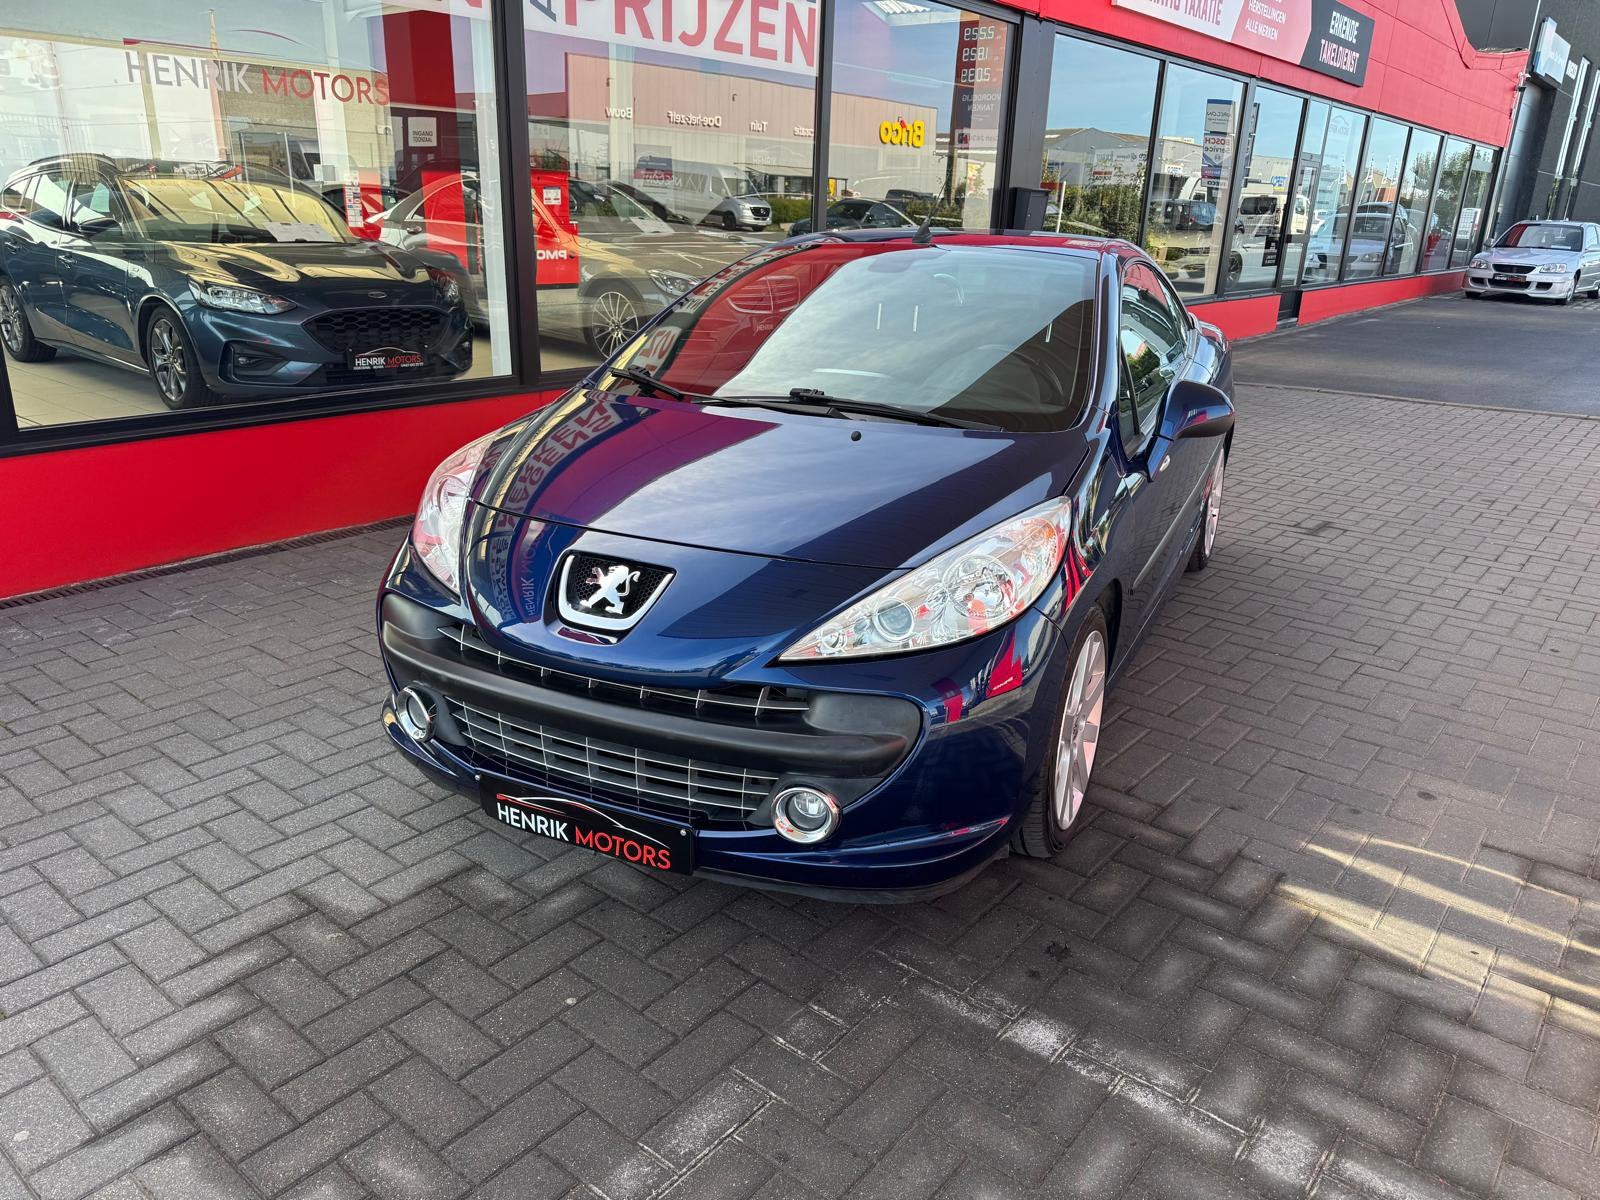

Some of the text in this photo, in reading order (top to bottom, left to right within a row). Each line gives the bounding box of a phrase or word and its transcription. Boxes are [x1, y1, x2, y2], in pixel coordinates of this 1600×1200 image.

[1247, 1, 1287, 24] HERSTELLINGEN
[1329, 10, 1360, 43] ERKENDE
[1244, 19, 1279, 40] ALLE MERKEN
[1319, 38, 1360, 74] TAKELDIENST
[125, 51, 391, 106] HENRIK MOTORS
[354, 354, 422, 367] HENRIK MOTORS
[496, 801, 671, 870] HENRIK MOTORS
